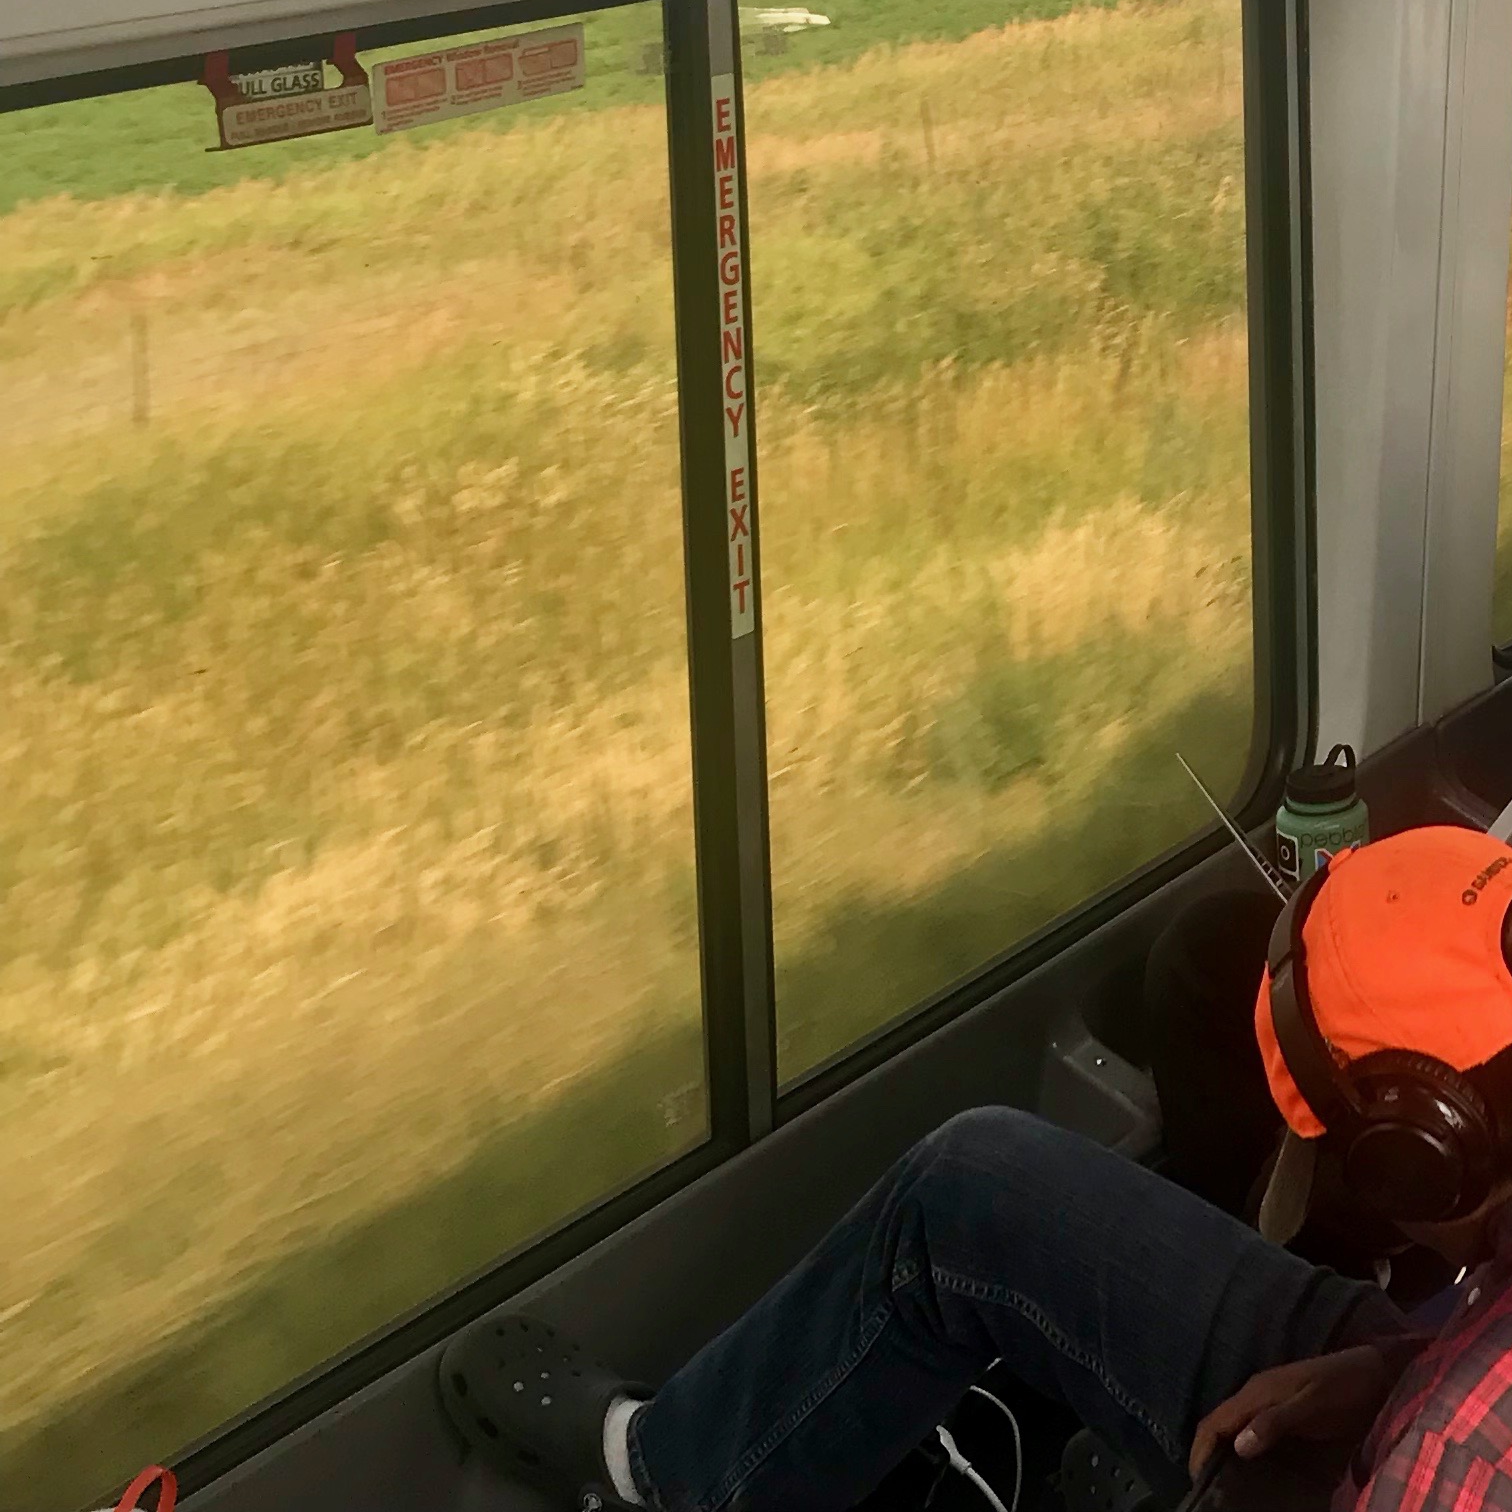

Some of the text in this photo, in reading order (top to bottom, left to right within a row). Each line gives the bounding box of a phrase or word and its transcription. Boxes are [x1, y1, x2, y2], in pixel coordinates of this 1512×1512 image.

[270, 72, 320, 93] GLASS
[236, 98, 322, 125] EMERGENCY
[329, 91, 357, 109] EXIT
[715, 97, 749, 615] EMERGENCY EXIT
